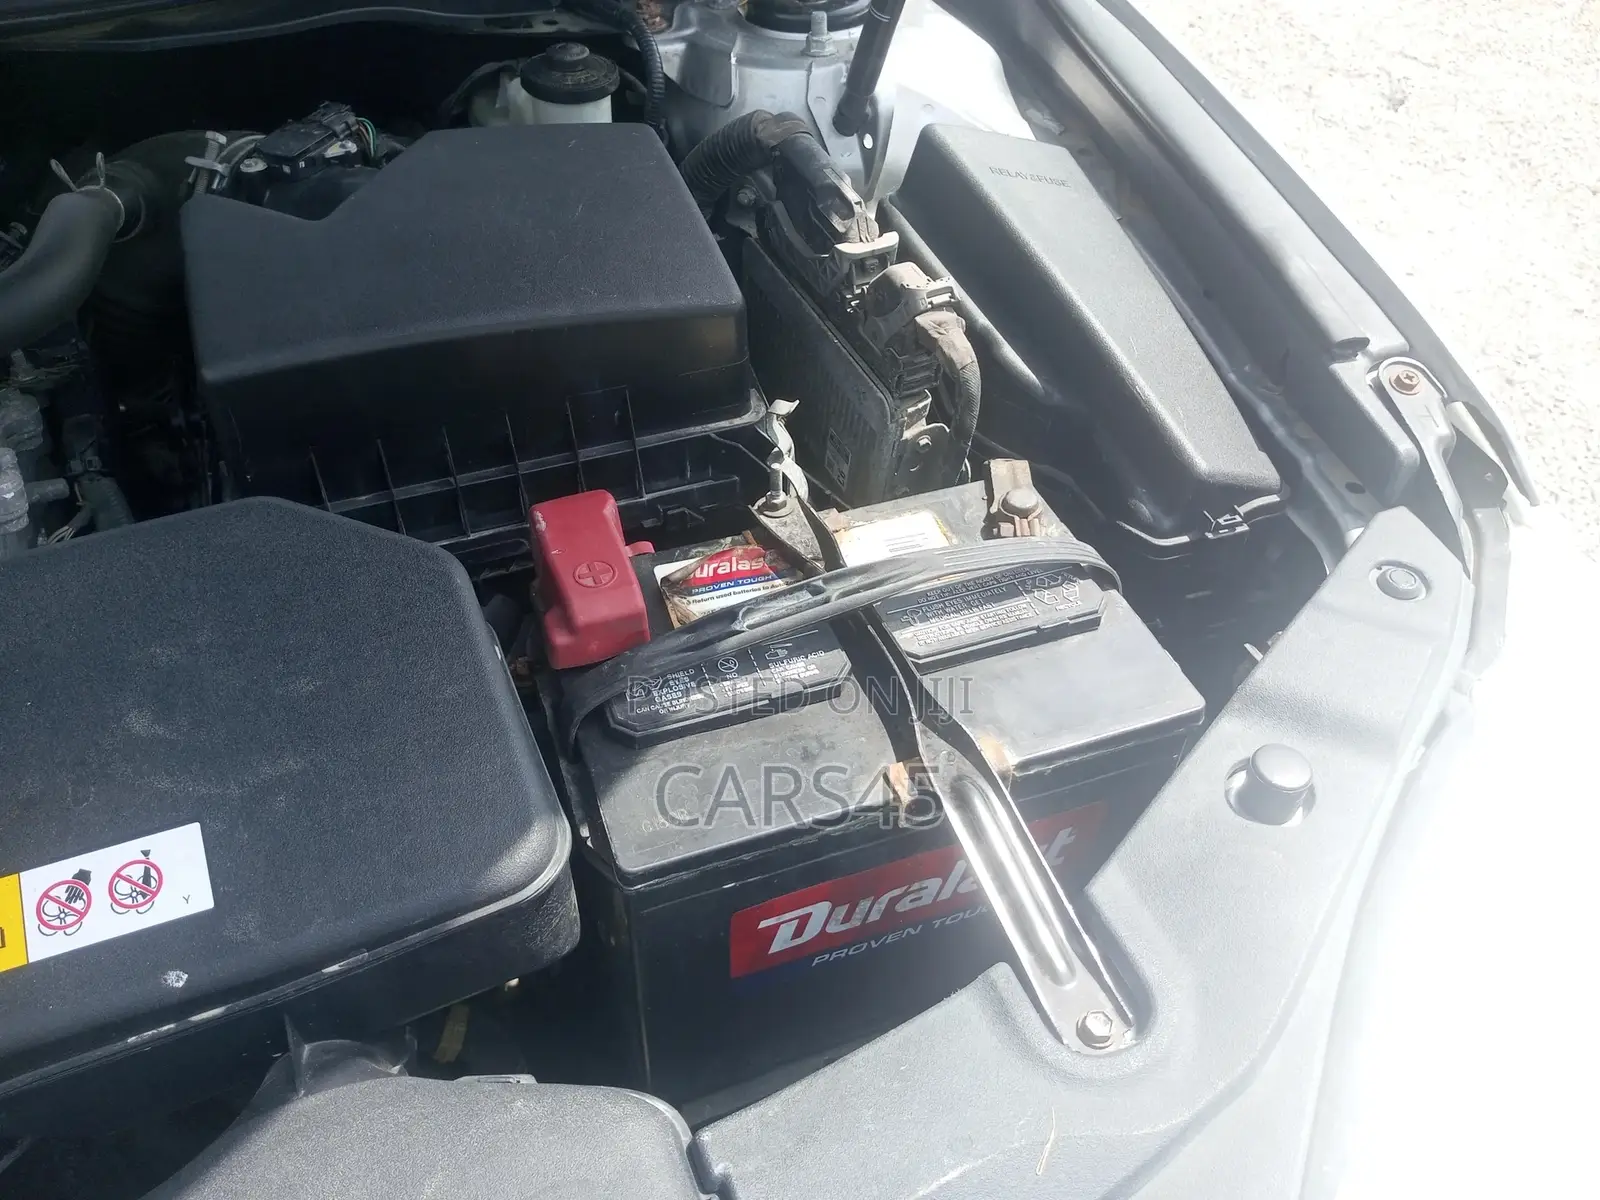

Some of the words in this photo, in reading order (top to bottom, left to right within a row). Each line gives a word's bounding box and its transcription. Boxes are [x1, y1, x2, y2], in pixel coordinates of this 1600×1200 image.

[690, 556, 764, 579] uralas
[692, 581, 734, 594] PROVEN
[737, 575, 772, 585] TOUGH
[733, 587, 761, 595] batteries
[922, 602, 944, 613] FLUSH
[946, 598, 962, 608] EYES
[963, 586, 1007, 602] IMMEDIATELY
[926, 608, 945, 618] WITH
[929, 613, 960, 624] MEDICAL
[768, 654, 807, 668] SULFURIC
[808, 650, 825, 660] ACID
[666, 668, 694, 680] SHIELD
[670, 676, 690, 686] EYES
[652, 682, 696, 697] EXPLOSIVE
[654, 692, 682, 703] GASES
[636, 706, 650, 714] CAN
[757, 827, 1077, 955] Duralt
[812, 925, 922, 967] PROVEN
[933, 903, 989, 929] TOU
